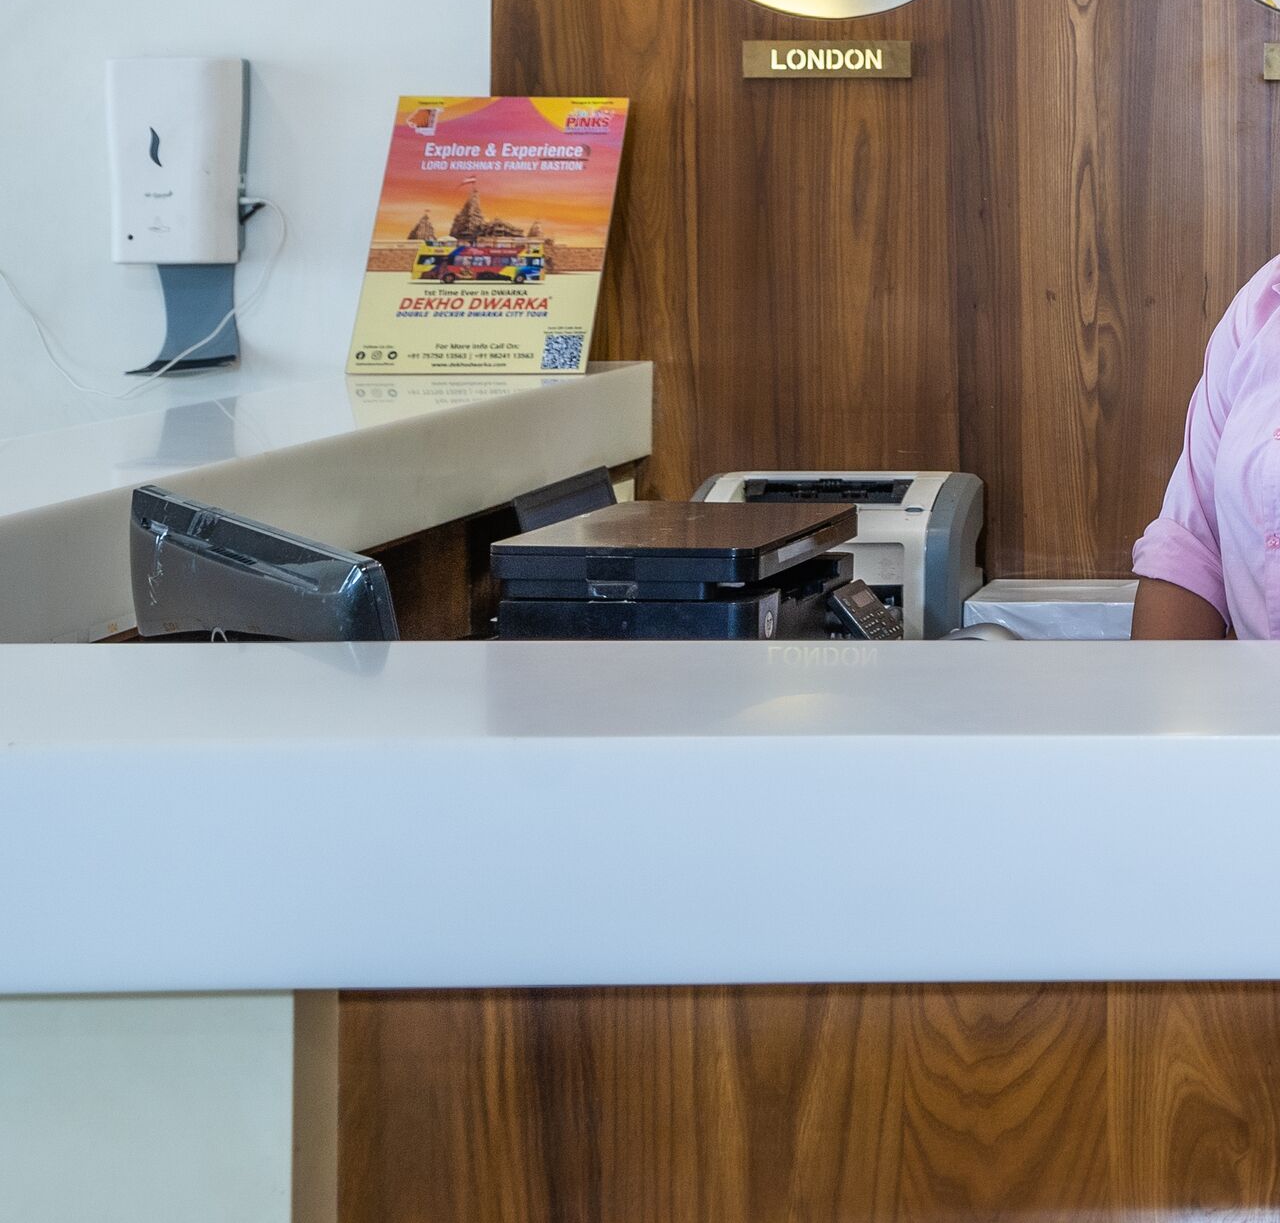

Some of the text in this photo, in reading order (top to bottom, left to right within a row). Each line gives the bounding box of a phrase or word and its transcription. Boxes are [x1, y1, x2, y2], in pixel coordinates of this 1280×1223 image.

[771, 48, 883, 70] LONDON
[424, 142, 584, 159] Explore & Experience
[421, 161, 583, 171] LORD KRISHNA'S FAMILY BASTION
[399, 297, 549, 310] DEKHO DWARKA
